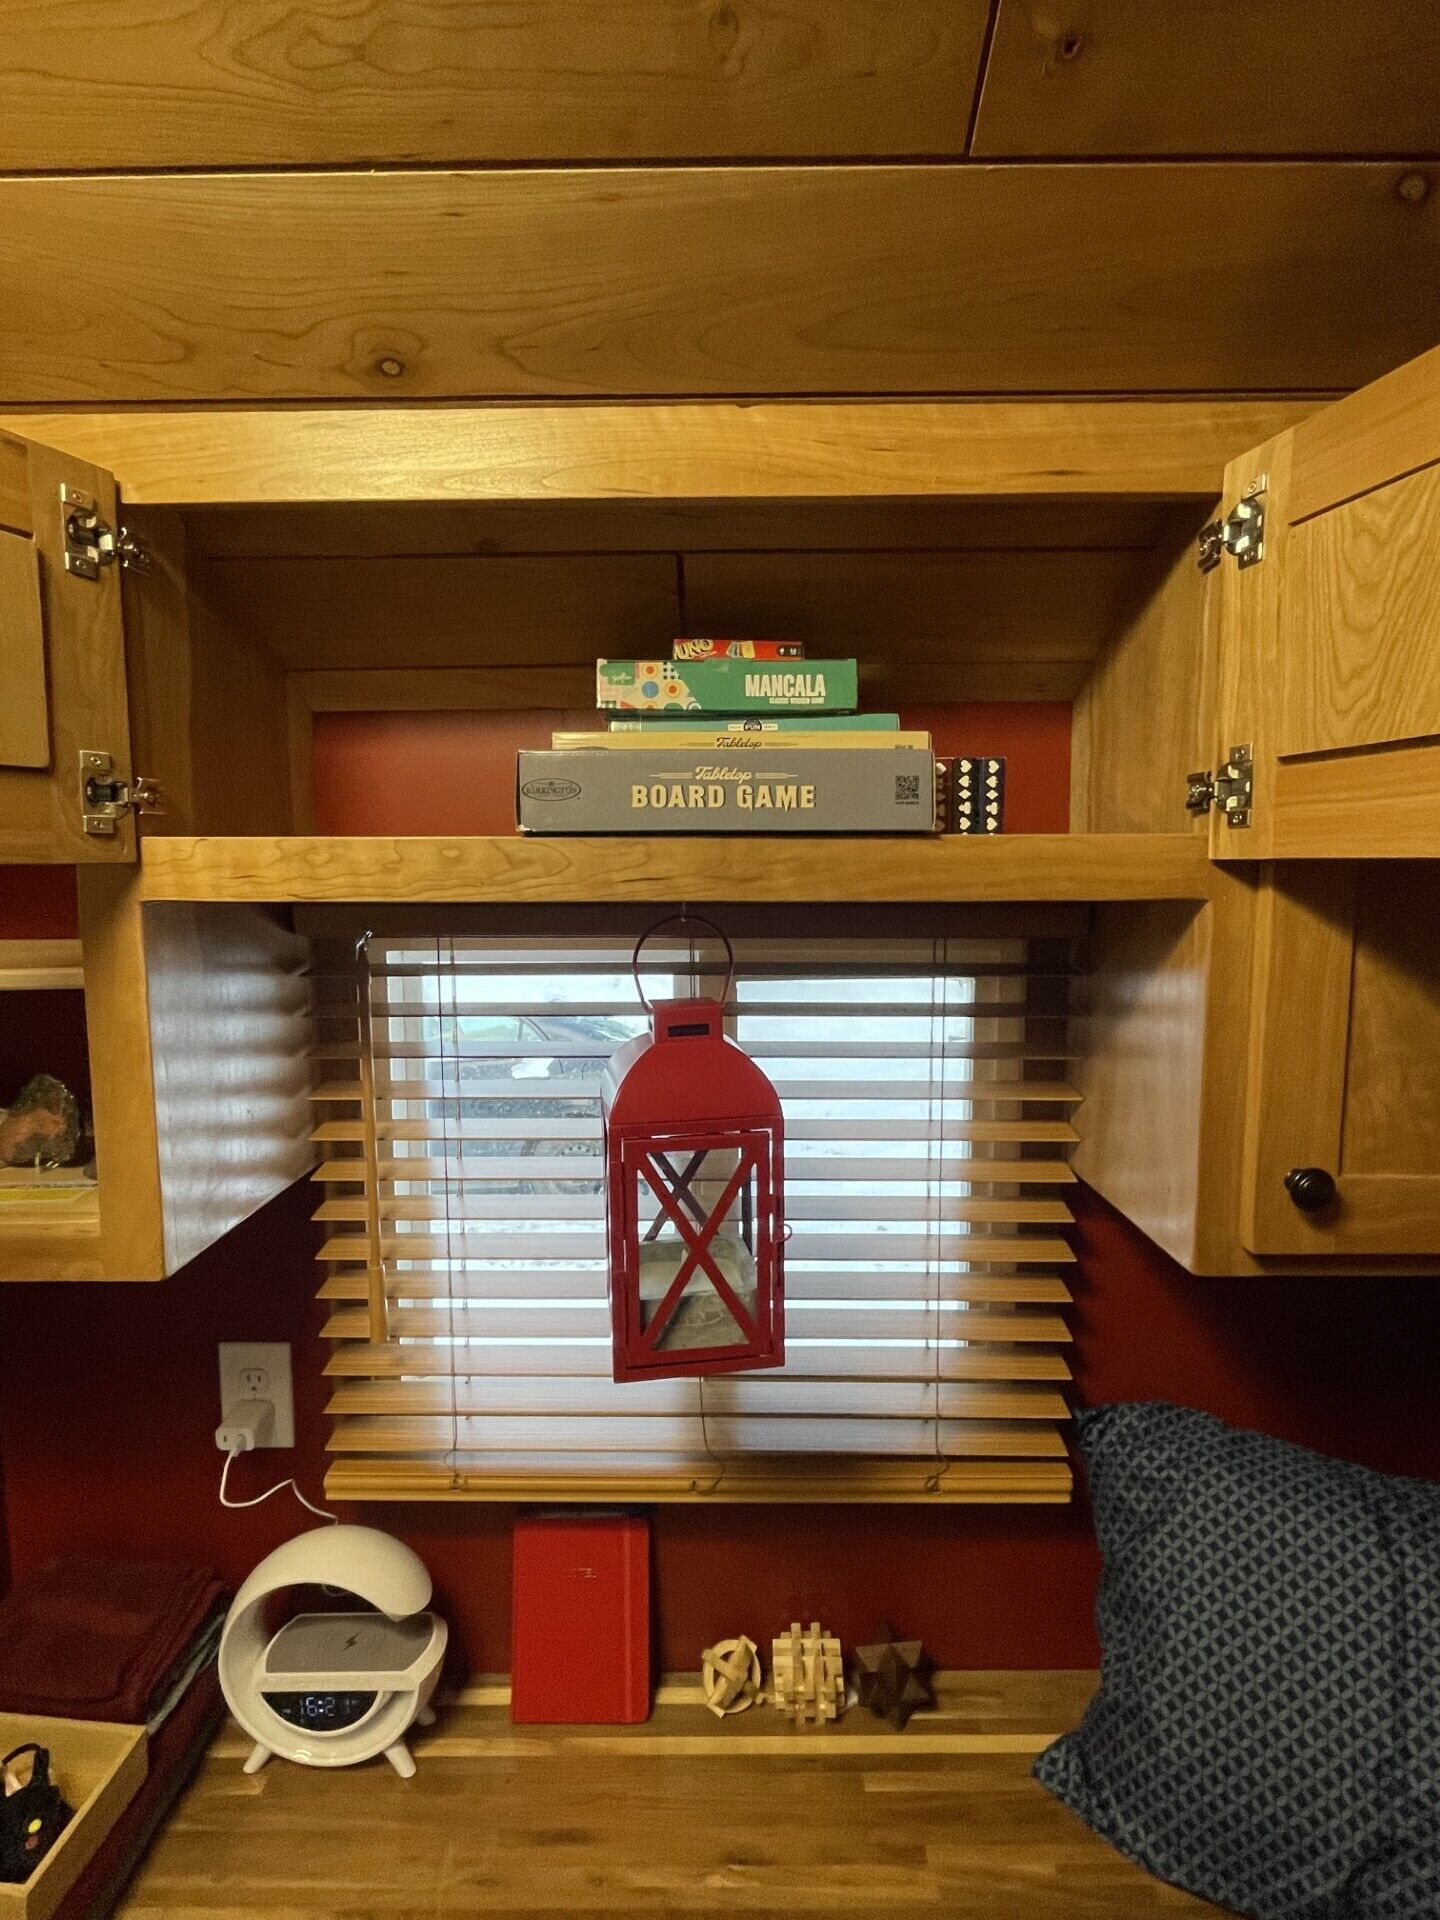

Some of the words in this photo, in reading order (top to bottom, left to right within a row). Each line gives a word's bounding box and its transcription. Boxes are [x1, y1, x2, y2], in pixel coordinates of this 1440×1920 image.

[674, 639, 713, 660] UNO
[745, 674, 826, 698] MANCALA
[716, 736, 762, 749] Tabletop
[694, 765, 755, 785] Tabletop
[631, 785, 725, 809] BOARD
[736, 785, 817, 812] GAME
